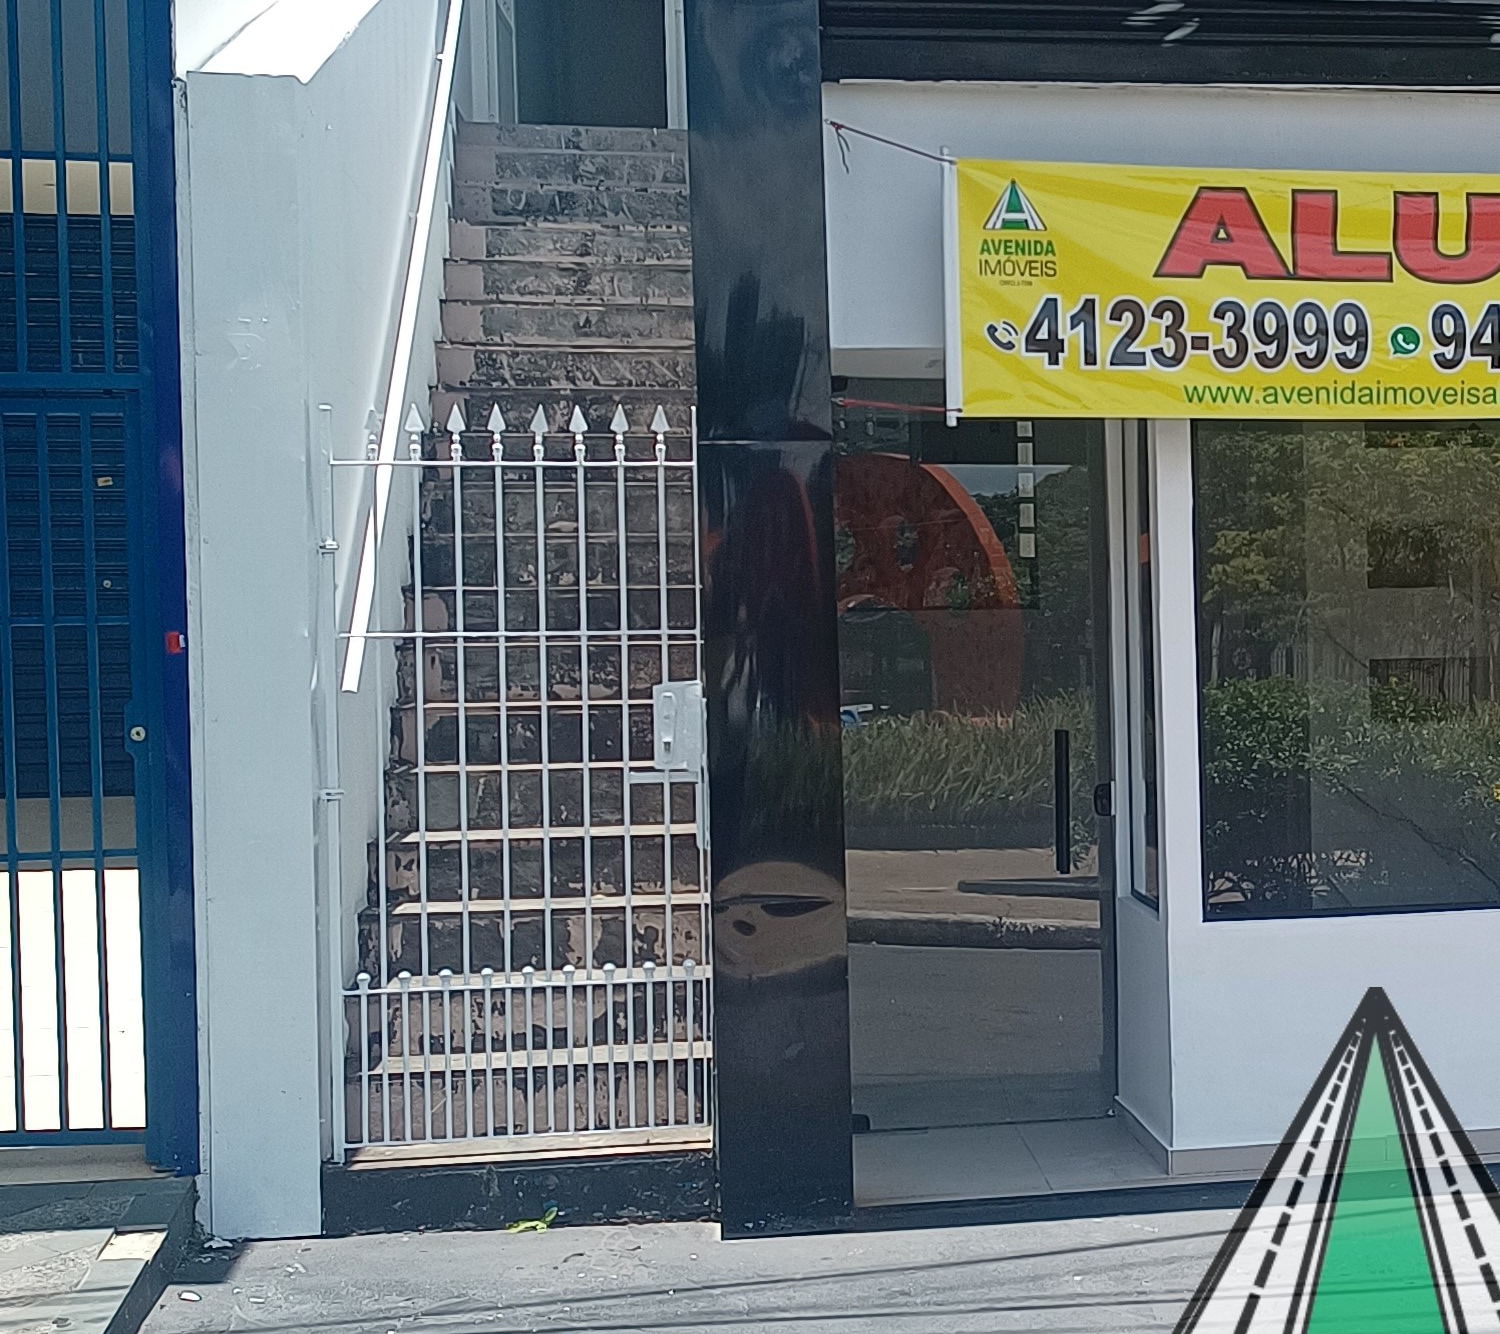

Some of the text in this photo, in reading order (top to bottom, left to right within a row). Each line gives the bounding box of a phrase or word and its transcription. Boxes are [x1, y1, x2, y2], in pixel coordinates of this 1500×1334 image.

[979, 238, 1057, 257] AVENIDA
[978, 255, 1058, 278] IMÓVEIS
[1023, 296, 1370, 370] 4123-3999
